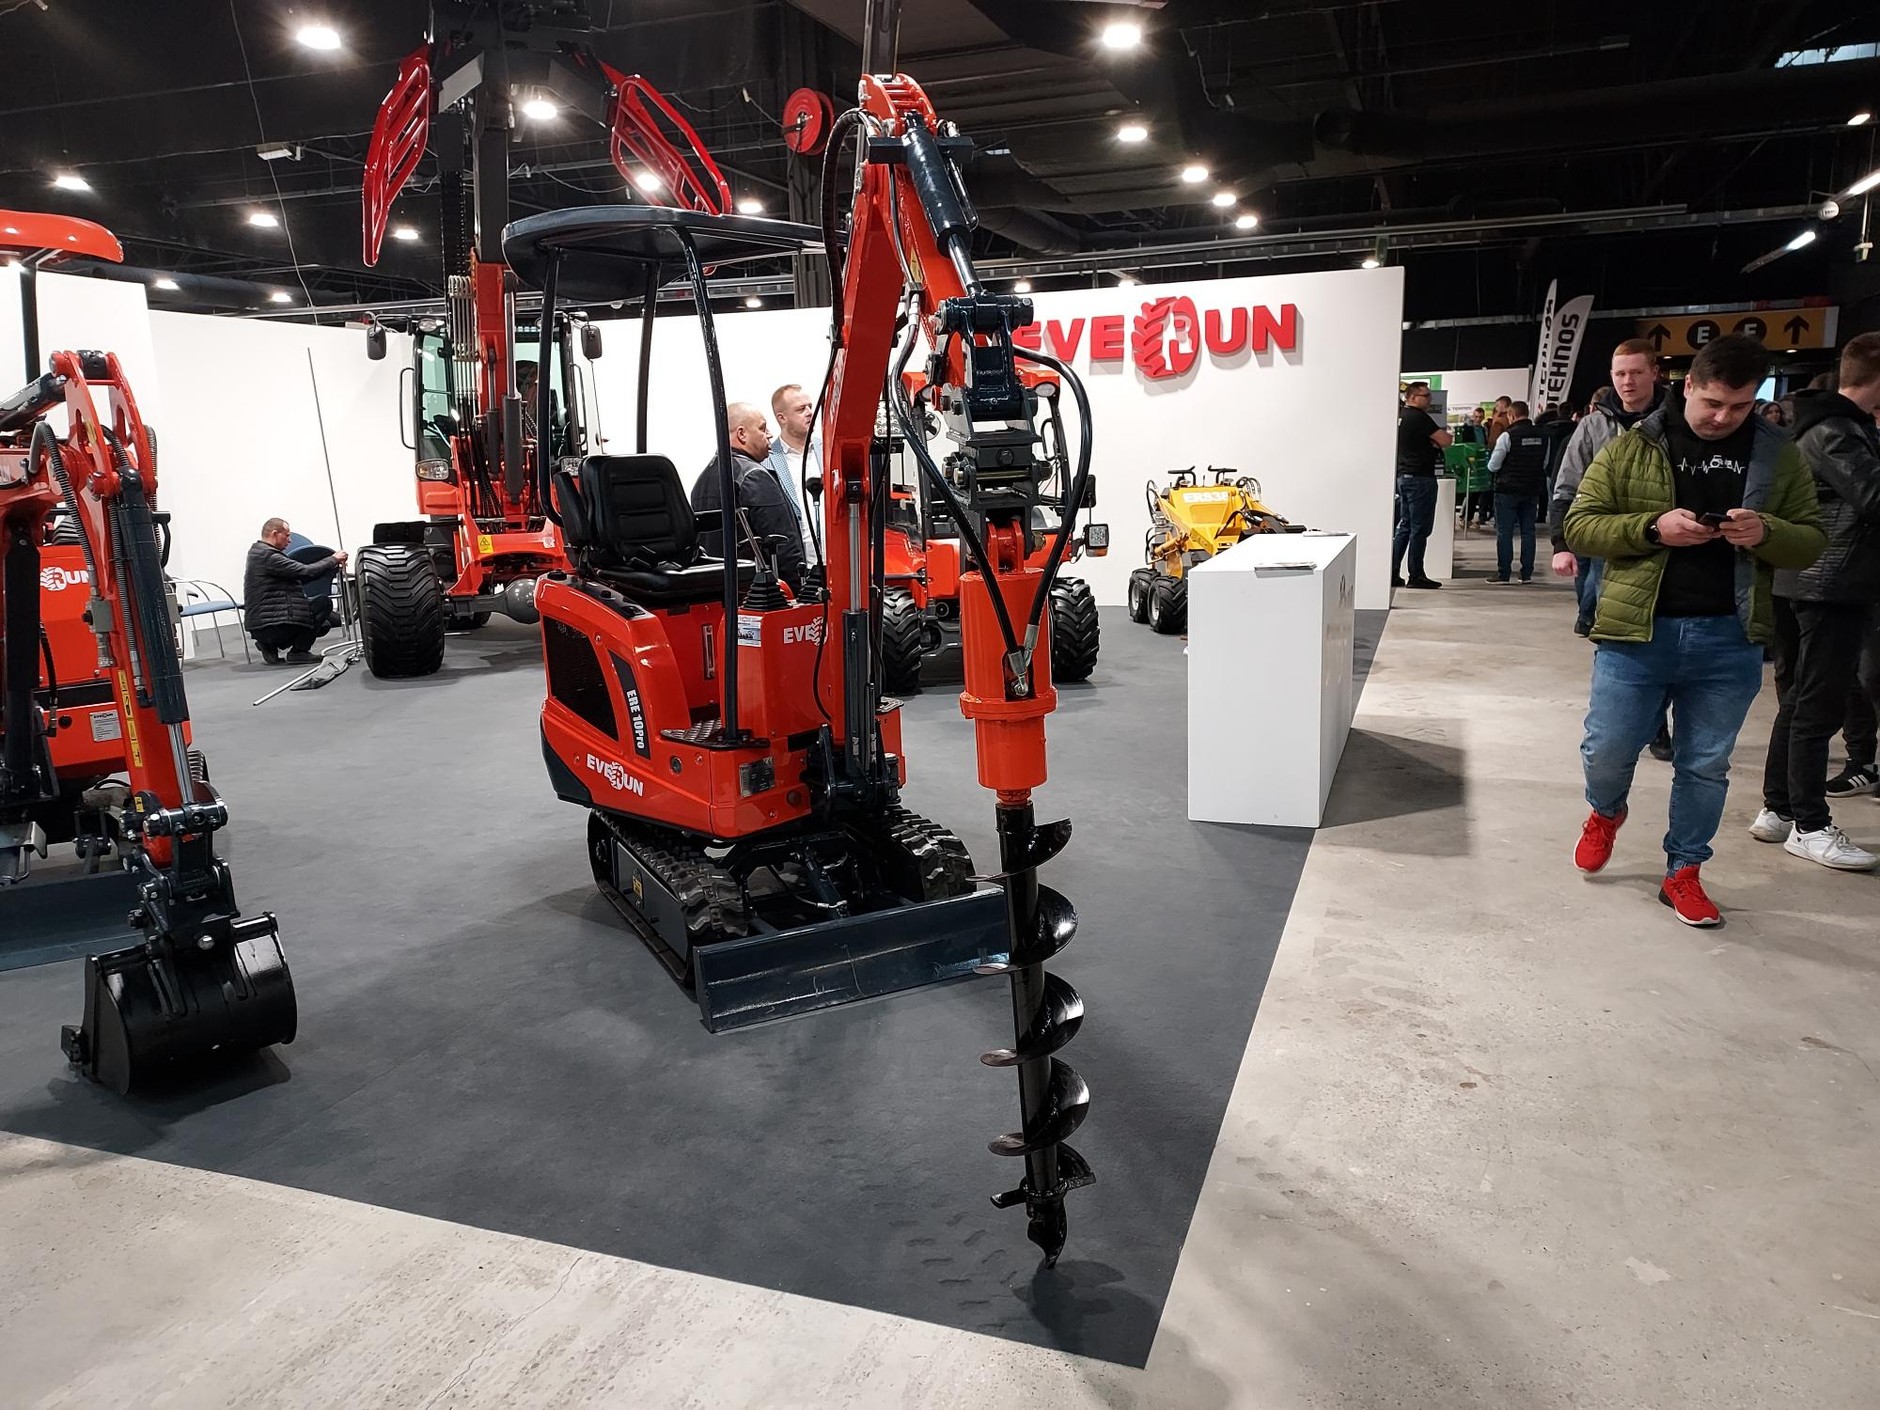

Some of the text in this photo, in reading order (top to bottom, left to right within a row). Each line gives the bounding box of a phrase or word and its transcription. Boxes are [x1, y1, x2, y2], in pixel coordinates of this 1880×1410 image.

[1697, 326, 1710, 343] E
[626, 689, 645, 749] ERE 10Pro
[586, 753, 644, 797] EVERUN
